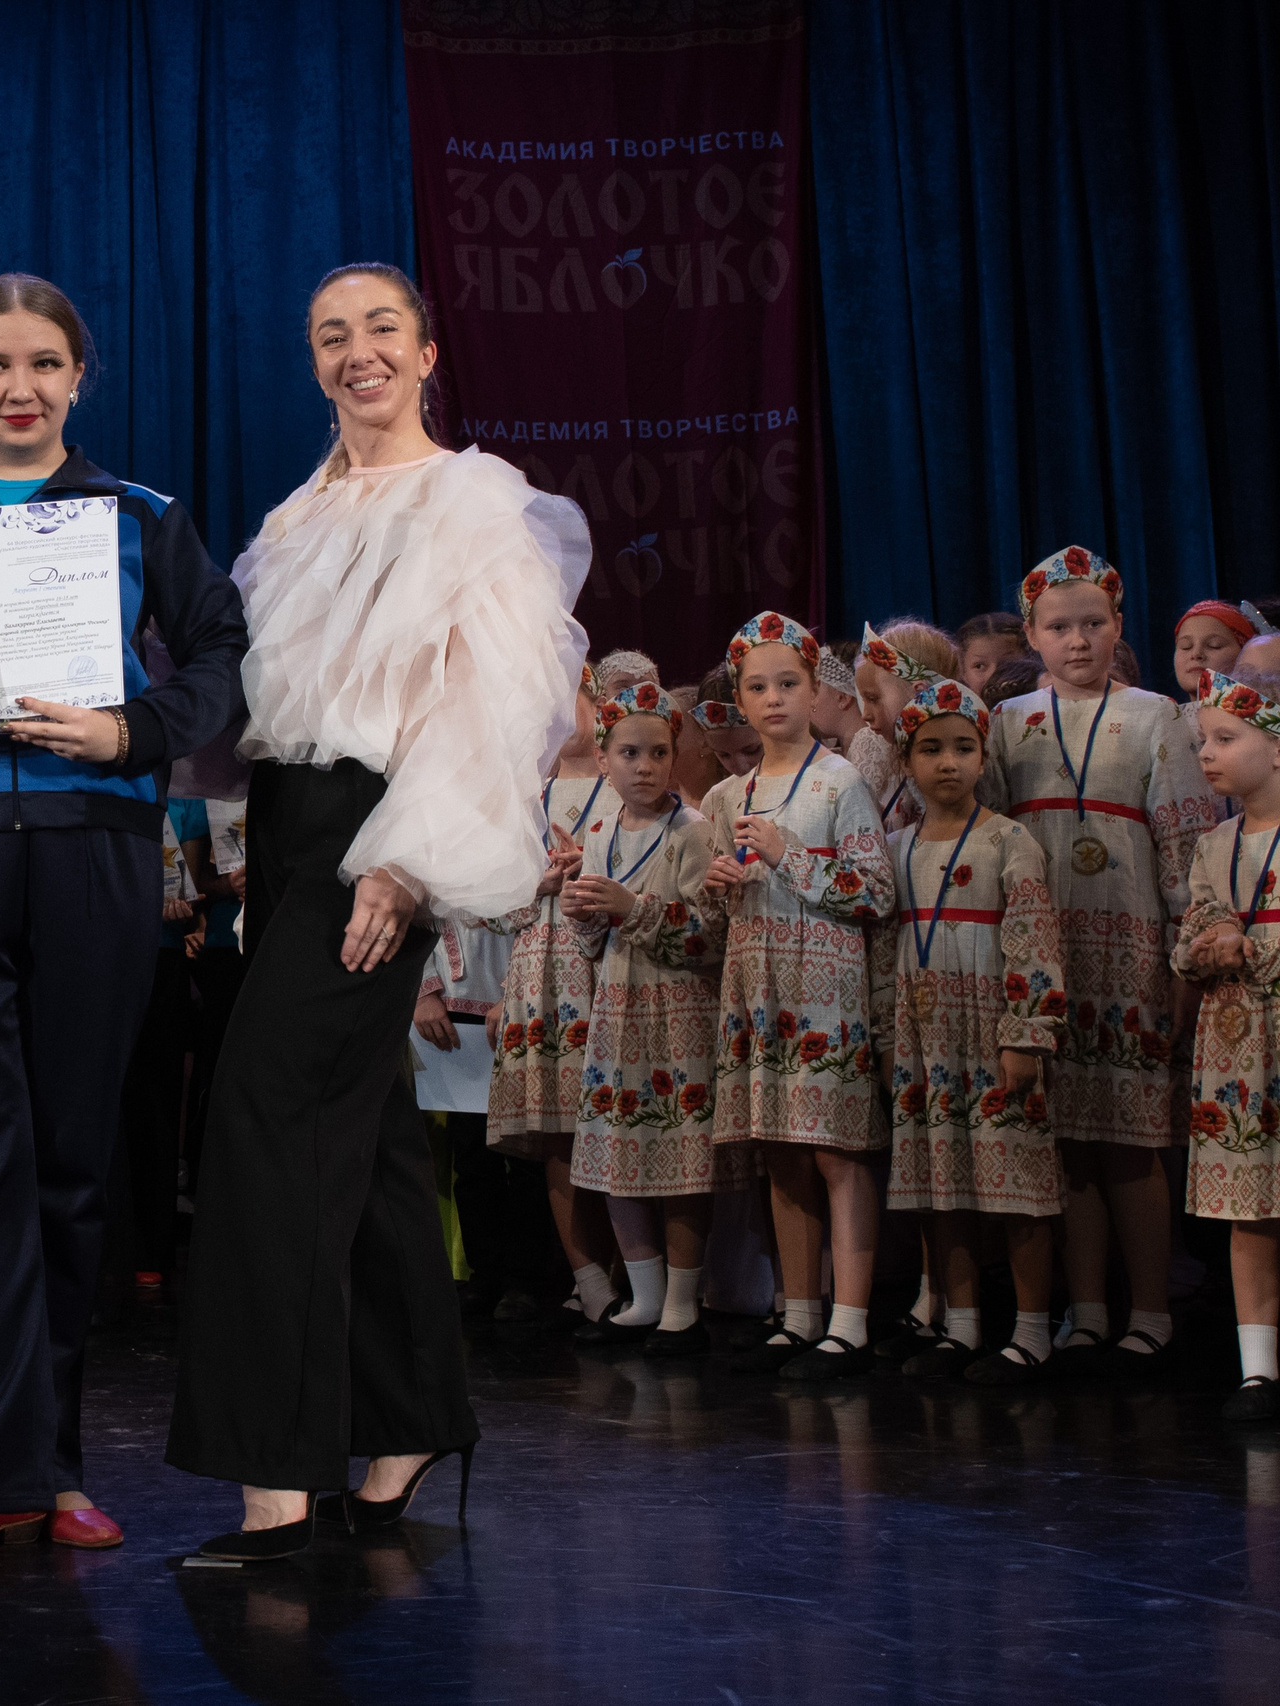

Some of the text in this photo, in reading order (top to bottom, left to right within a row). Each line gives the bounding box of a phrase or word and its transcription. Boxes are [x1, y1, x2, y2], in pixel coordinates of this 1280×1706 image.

[445, 131, 785, 164] АКАДЕМИЯ ТВОРЧЕСТВА
[458, 406, 800, 444] АКАДЕМИЯ ТВОРЧЕСТВА
[27, 566, 109, 587] Диплом
